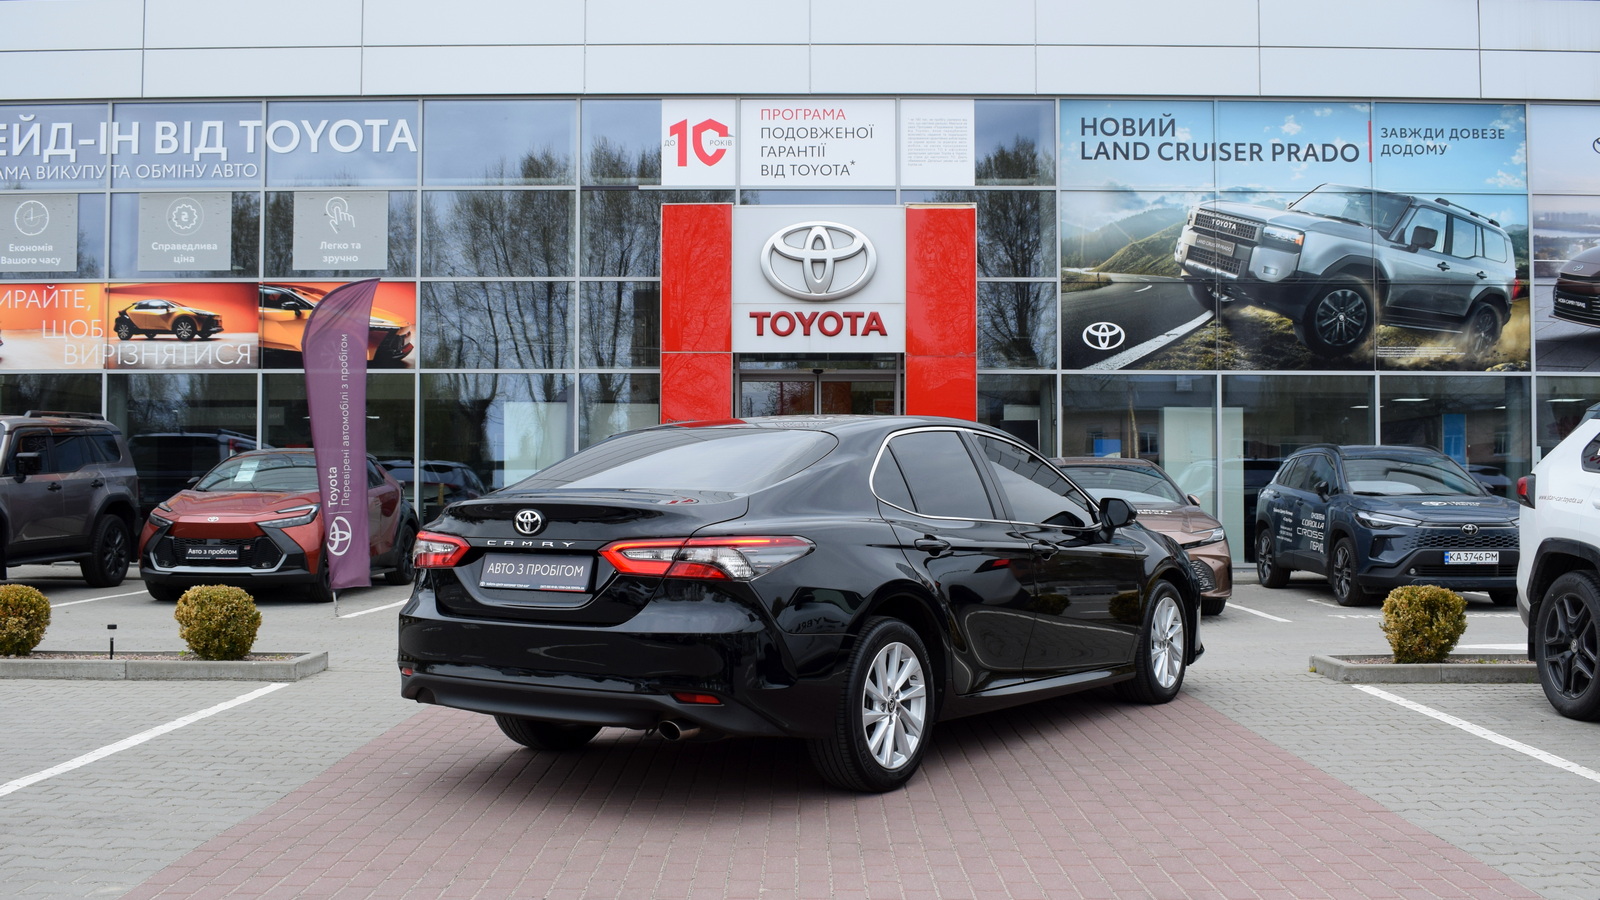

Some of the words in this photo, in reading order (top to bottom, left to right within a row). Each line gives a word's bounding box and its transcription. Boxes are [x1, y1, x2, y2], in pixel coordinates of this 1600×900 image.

[760, 108, 846, 121] ПРОГРАМА
[1080, 112, 1176, 137] НОВИЙ
[155, 120, 228, 162] ВІД
[239, 118, 418, 154] TOYOTA
[760, 124, 875, 142] ПОДОВЖЕНОЇ
[1380, 127, 1445, 141] ЗАВЖДИ
[1448, 128, 1505, 141] ДОВЕЗЕ
[664, 139, 676, 147] ДО
[760, 143, 826, 158] ГАРАНТІЇ
[1080, 142, 1150, 162] LAND
[1156, 142, 1264, 162] CRUISER
[1271, 142, 1360, 163] PRADO
[1380, 144, 1448, 157] ДОДОМУ
[36, 164, 107, 180] ВИКУПУ
[111, 164, 131, 179] ТА
[135, 163, 207, 180] ОБМІНУ
[211, 163, 258, 179] АВТО
[760, 164, 786, 178] ВІД
[1212, 219, 1236, 230] TOYOTA
[9, 243, 53, 252] Економія
[151, 241, 218, 254] Справедлива
[319, 241, 347, 251] Легко
[350, 243, 362, 251] та
[0, 256, 38, 265] Вашого
[39, 257, 61, 266] часу
[173, 253, 196, 265] ціна
[322, 254, 359, 265] зручно
[41, 319, 103, 342] ЩОБ
[749, 311, 888, 337] TOYOTA
[64, 344, 251, 366] ВИРІЗНЯТИСЯ
[338, 333, 350, 381] пробігом
[339, 391, 350, 447] автомобілі
[340, 449, 352, 506] Перевірені
[328, 466, 340, 508] Toyota
[1302, 518, 1325, 529] COROLLA
[1296, 527, 1324, 540] CROSS
[487, 540, 576, 548] CAMRY
[208, 548, 237, 556] пробігом
[1449, 552, 1462, 562] KA
[1463, 552, 1484, 562] 3746
[1485, 552, 1498, 562] PM
[487, 562, 515, 575] АВТО
[516, 563, 524, 575] З
[526, 563, 584, 577] ПРОБІГОМ
